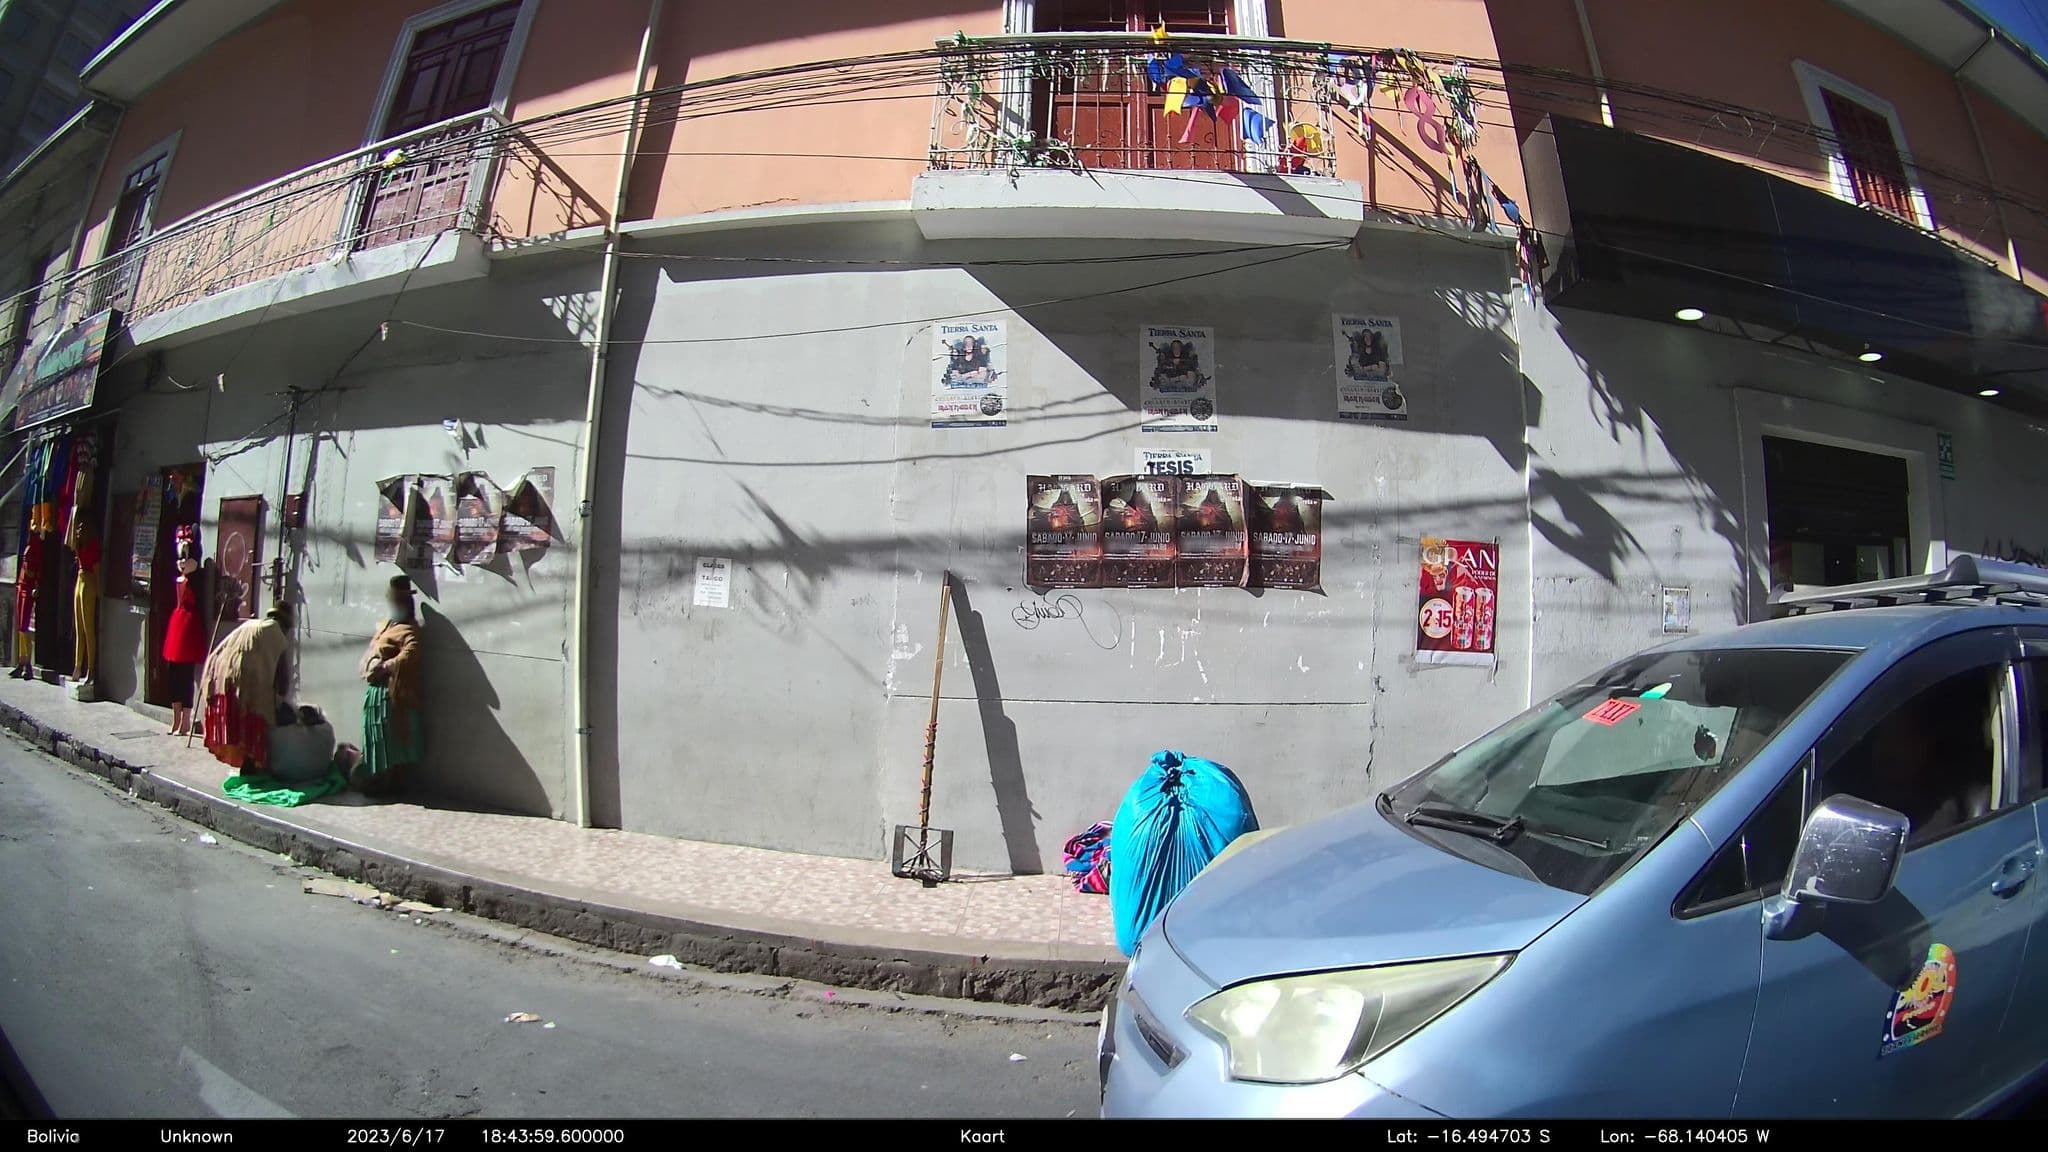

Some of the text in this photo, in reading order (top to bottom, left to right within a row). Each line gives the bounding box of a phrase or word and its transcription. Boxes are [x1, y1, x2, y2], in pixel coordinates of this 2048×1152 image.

[941, 324, 998, 334] TIERRA SANTA
[1148, 328, 1206, 338] TIERRA SANTA
[1146, 460, 1194, 475] TESIS
[1294, 532, 1316, 546] JUNIO
[1423, 545, 1496, 569] GRAN
